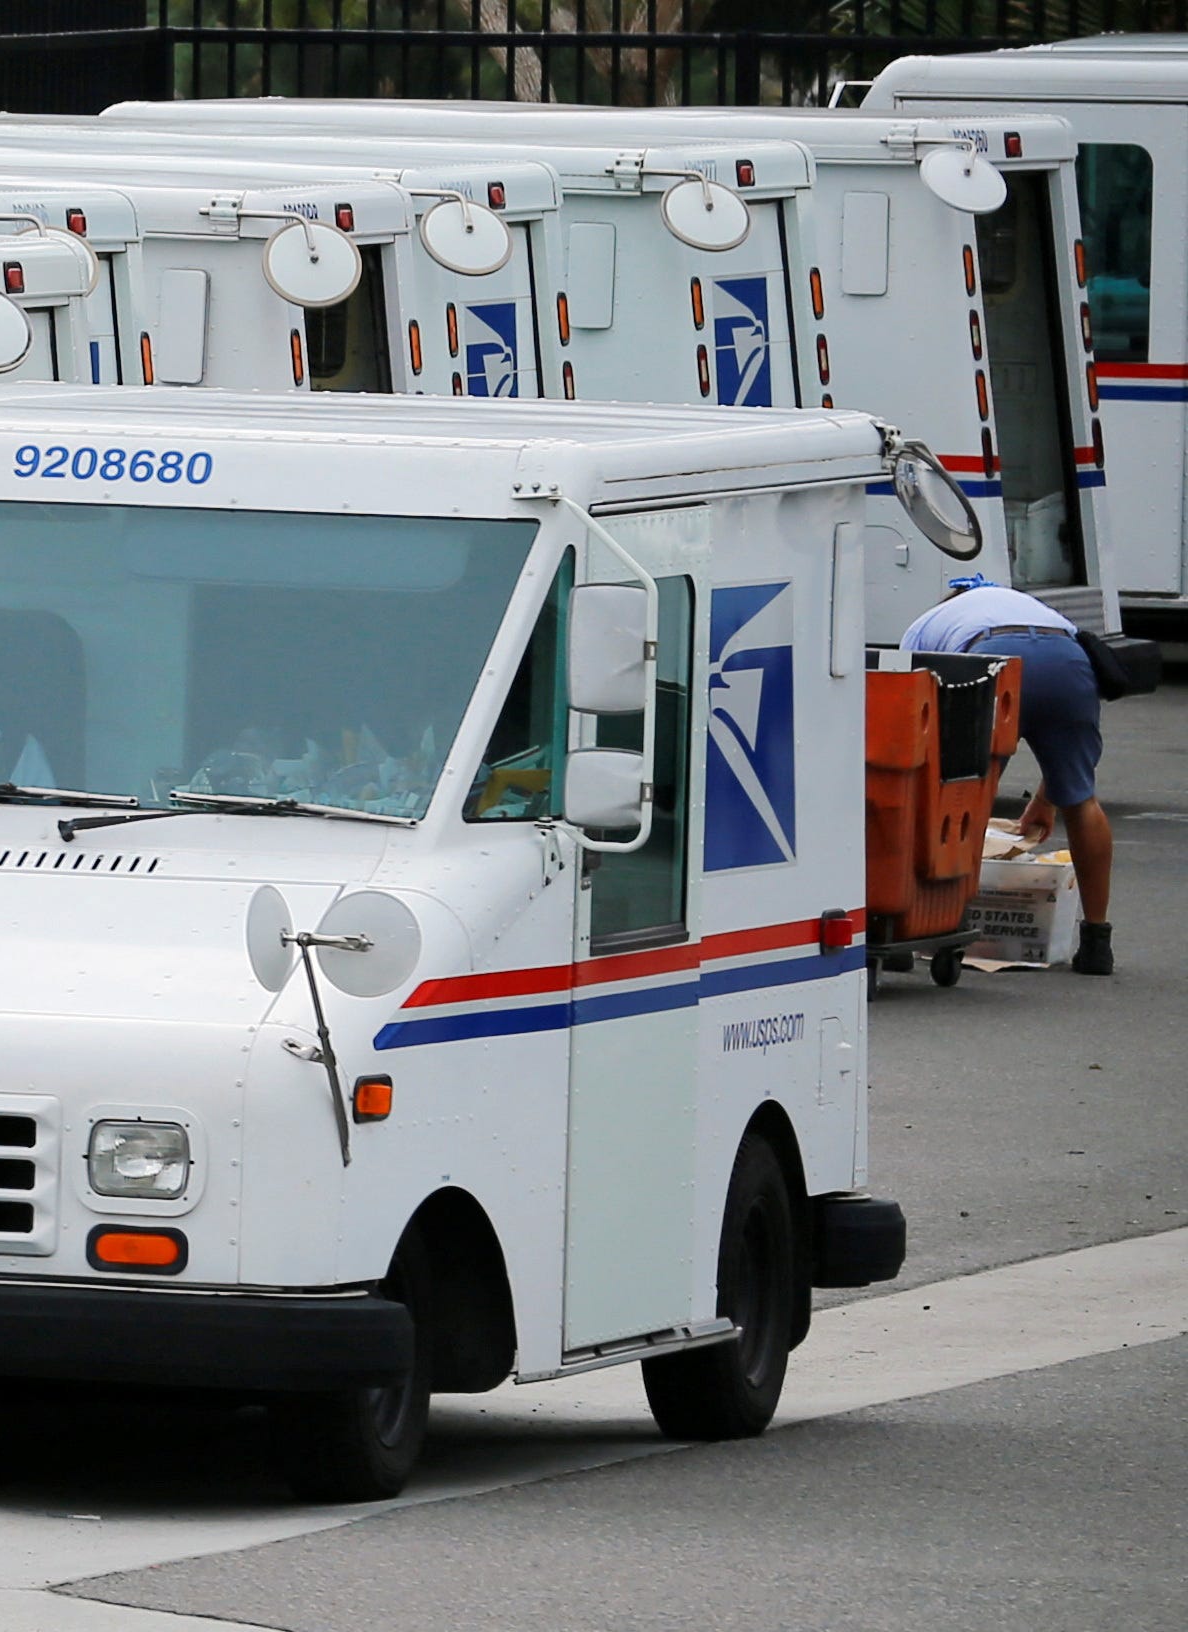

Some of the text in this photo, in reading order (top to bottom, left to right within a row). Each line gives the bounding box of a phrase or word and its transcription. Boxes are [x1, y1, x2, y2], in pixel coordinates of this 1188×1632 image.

[14, 445, 213, 484] 9208680
[985, 911, 1034, 923] STATES
[983, 924, 1039, 938] SERVICE
[723, 1013, 804, 1056] www.usps.com
